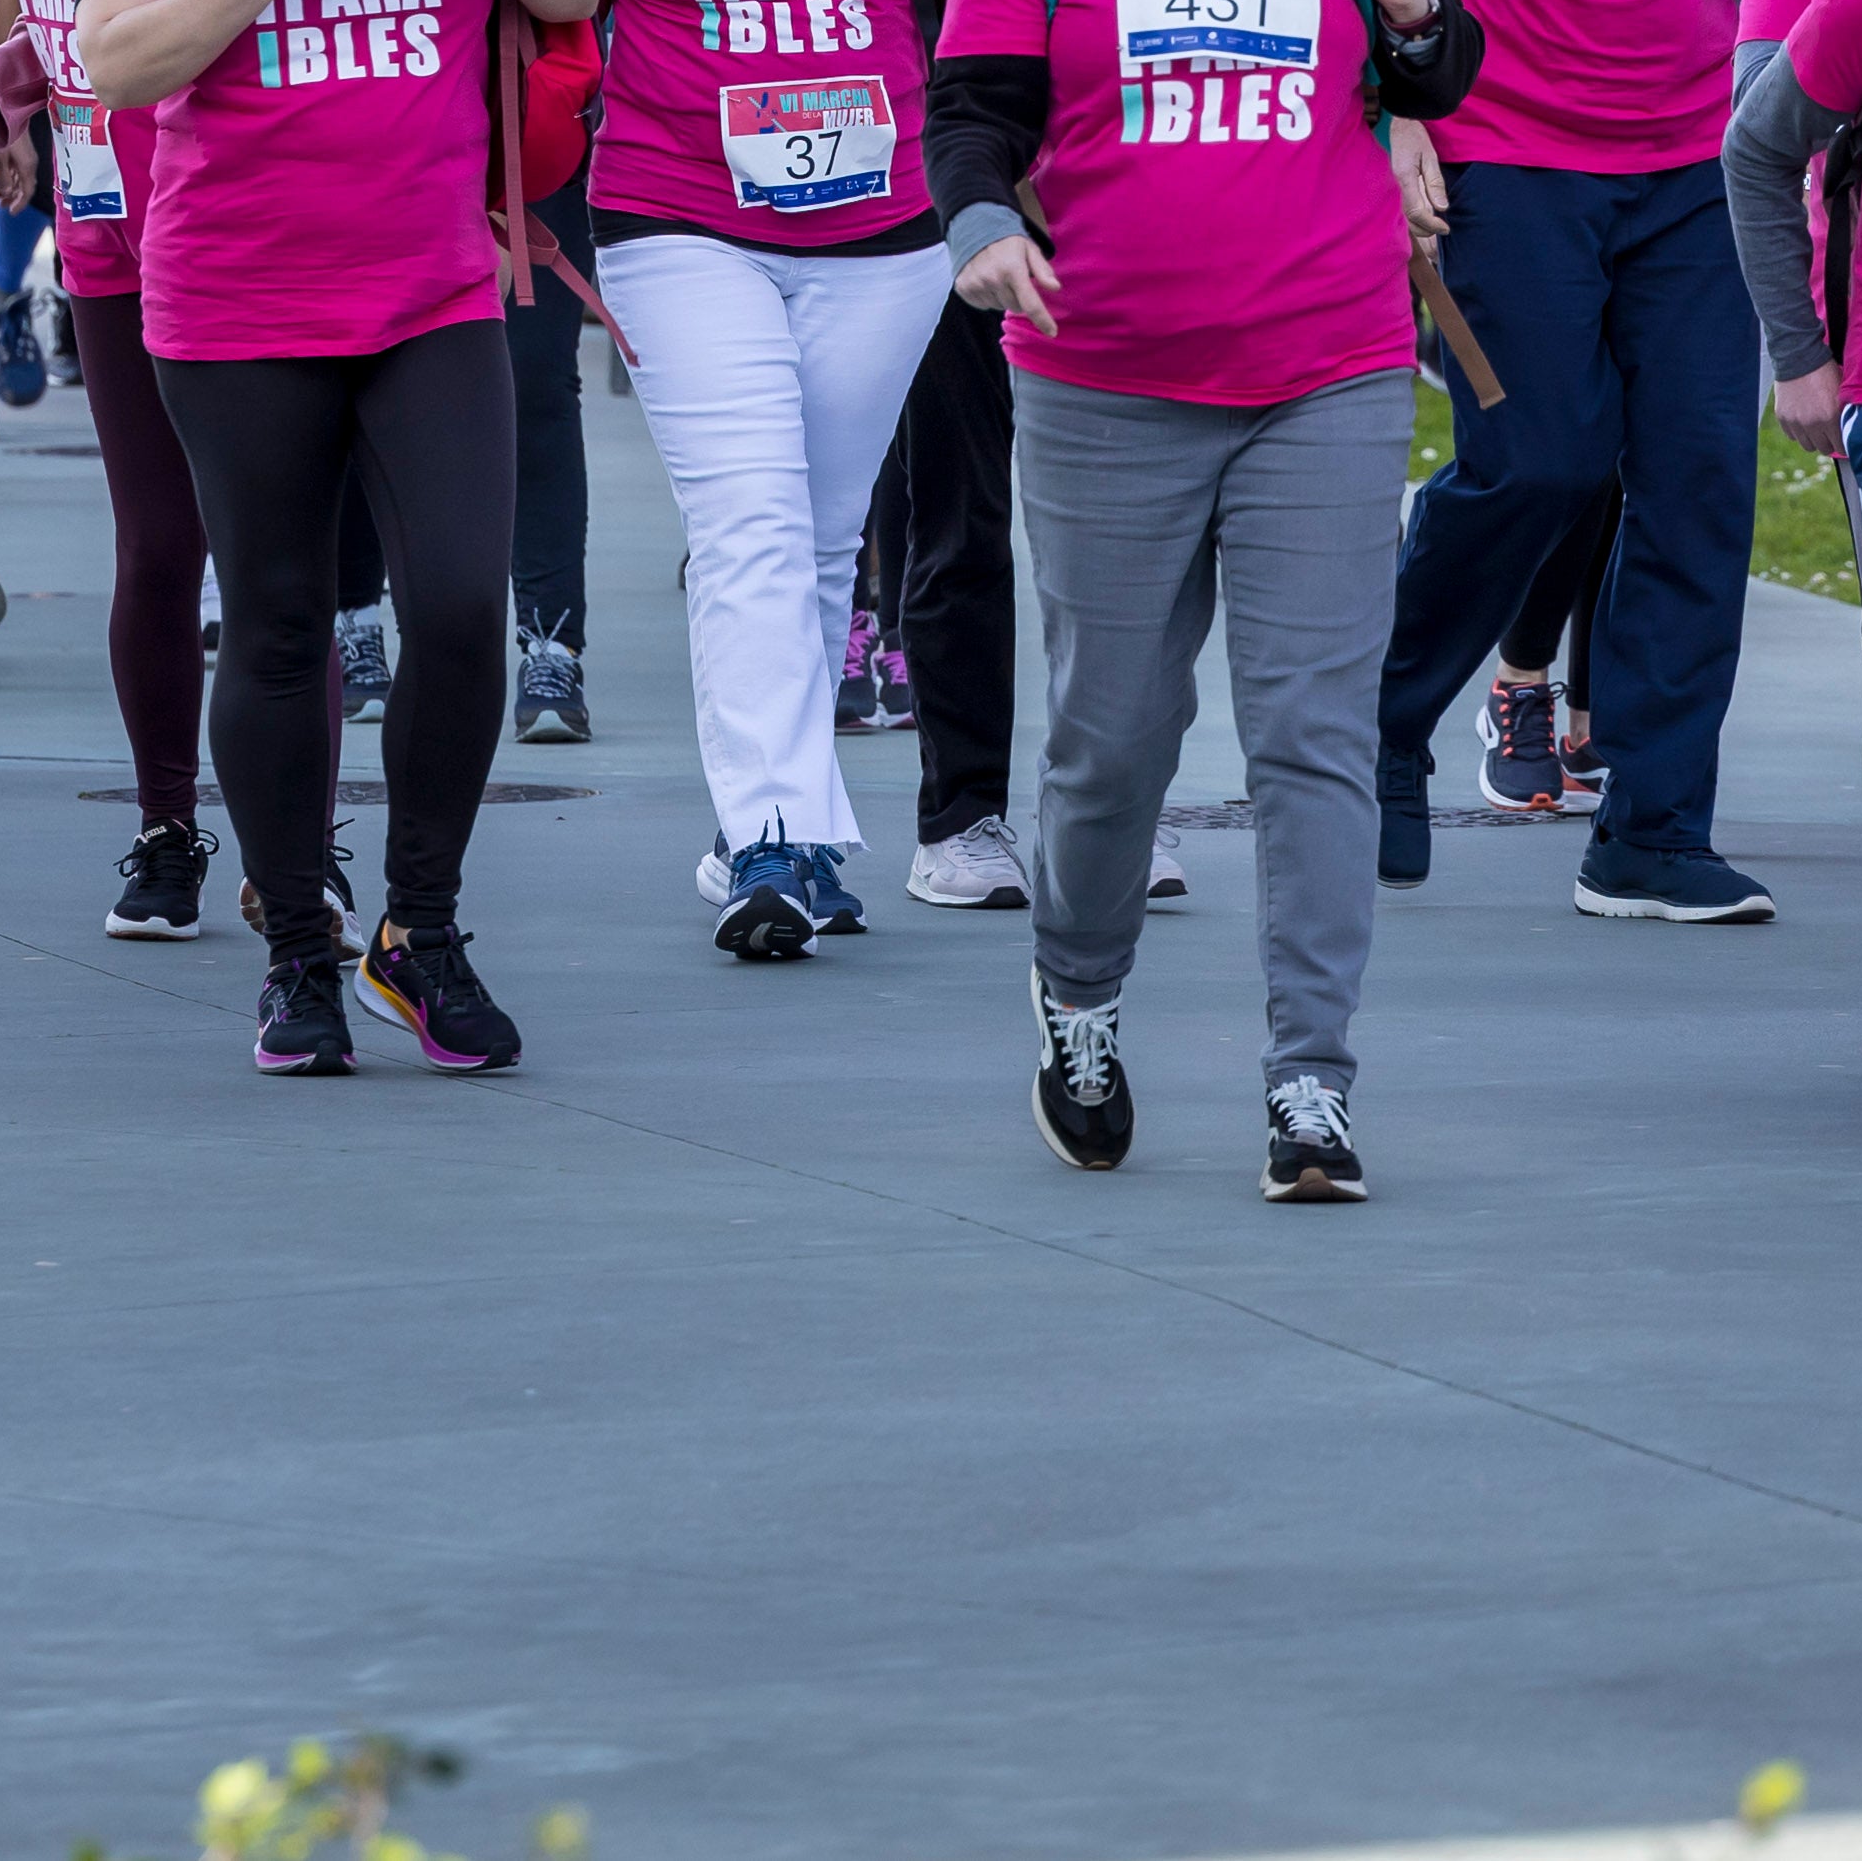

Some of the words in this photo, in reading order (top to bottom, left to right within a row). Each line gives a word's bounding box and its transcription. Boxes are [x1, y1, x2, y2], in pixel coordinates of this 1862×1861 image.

[780, 93, 797, 113] VI
[802, 88, 872, 112] MARCHA
[822, 108, 875, 130] MUJER
[785, 131, 843, 180] 37
